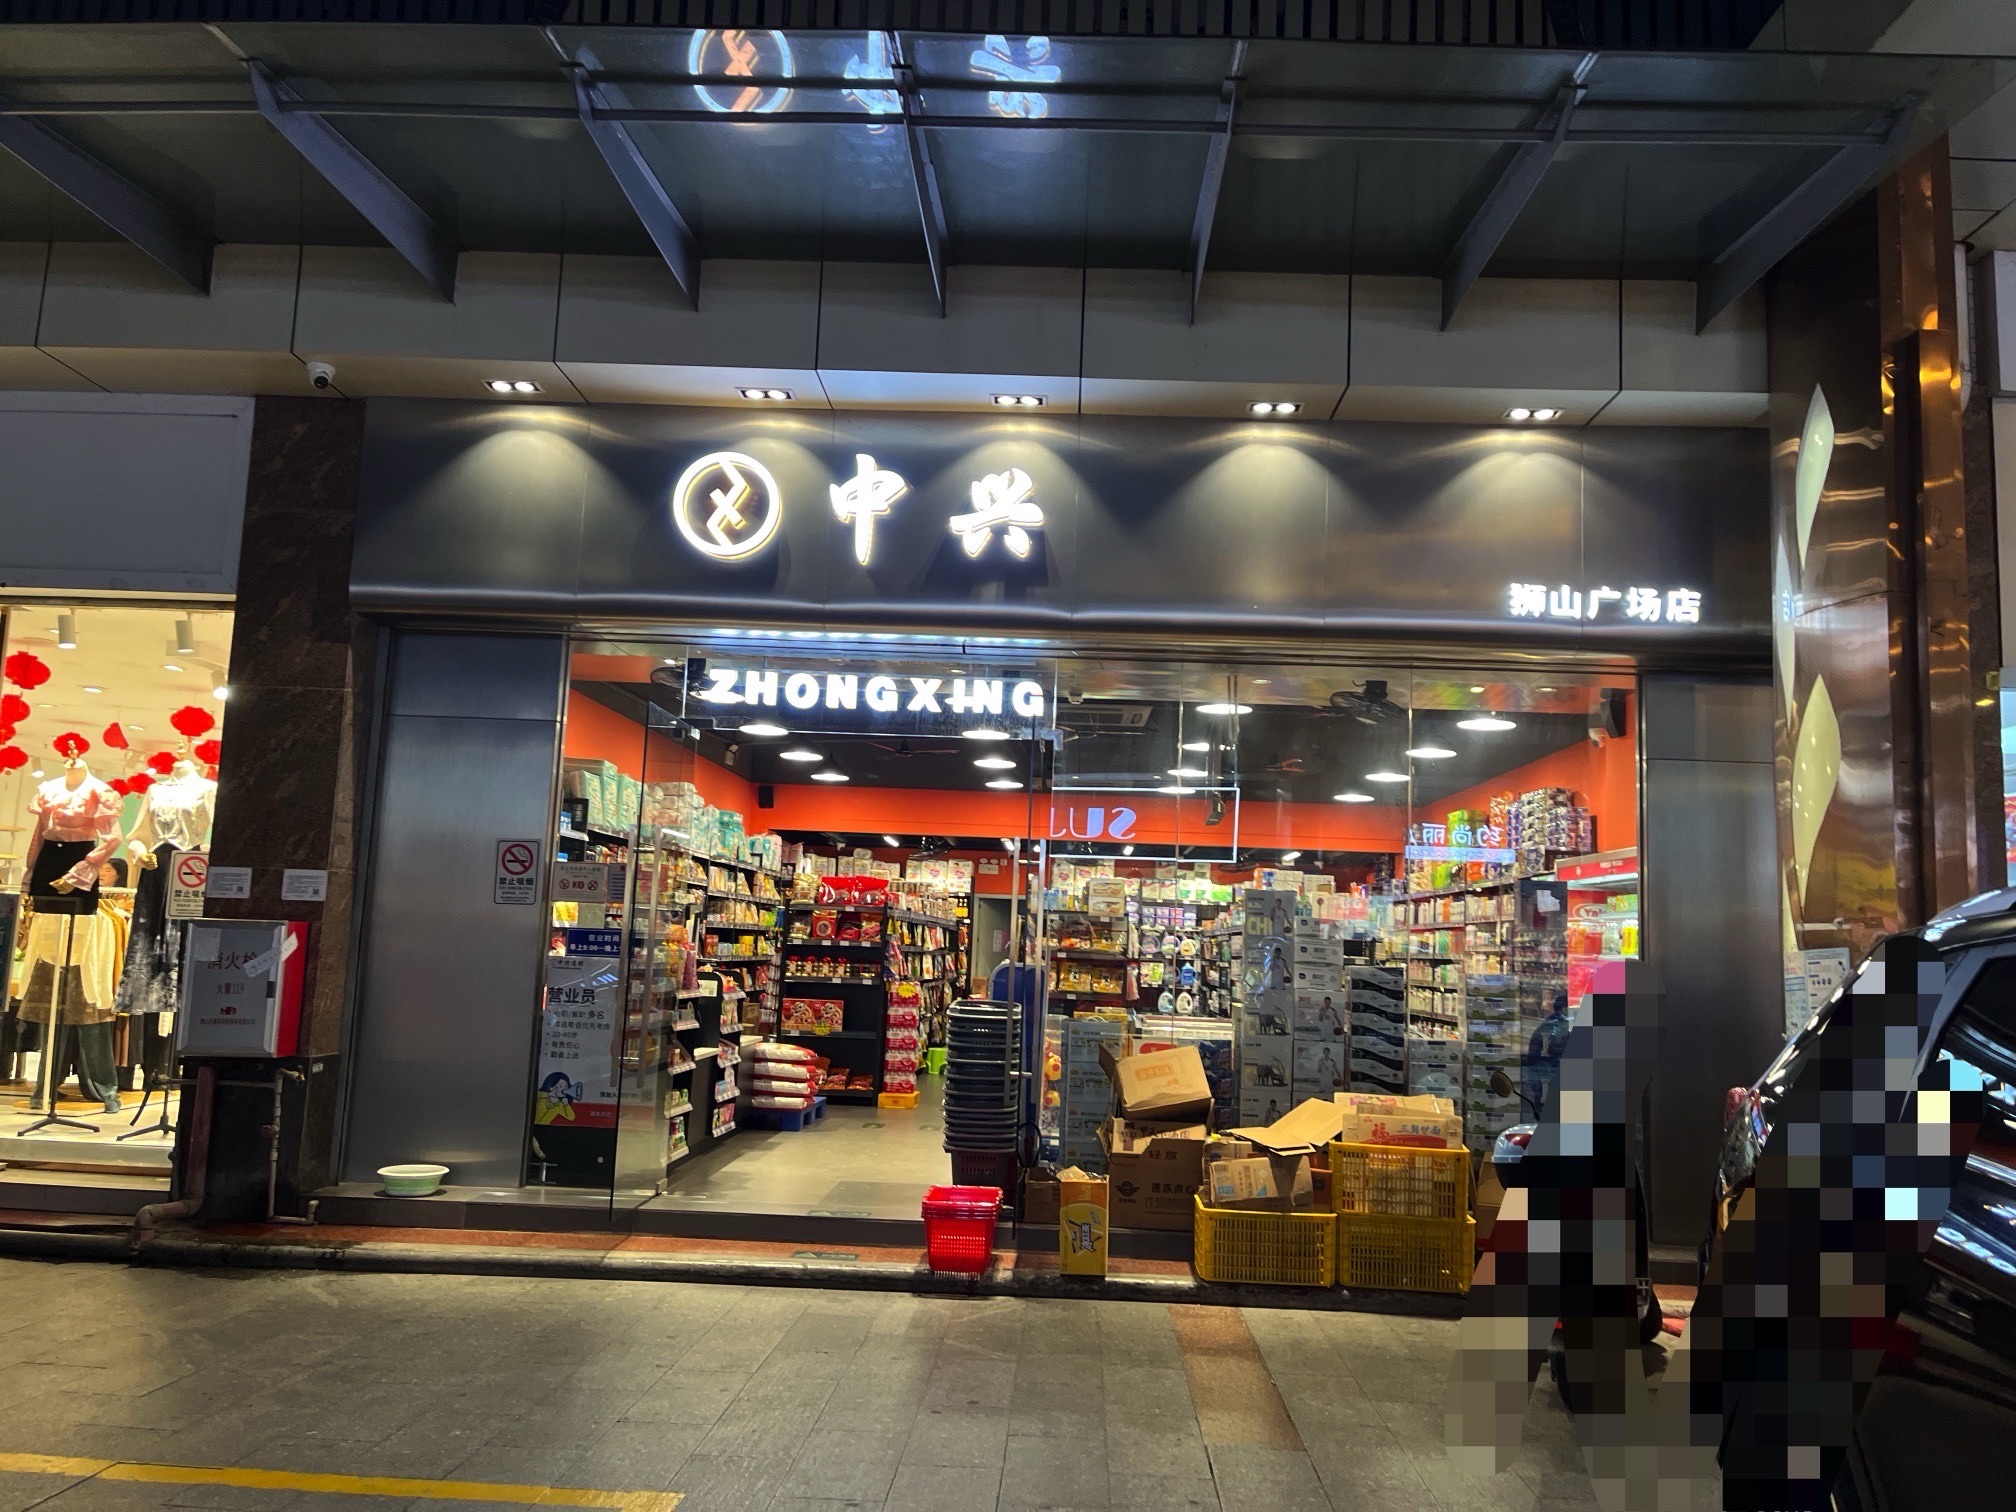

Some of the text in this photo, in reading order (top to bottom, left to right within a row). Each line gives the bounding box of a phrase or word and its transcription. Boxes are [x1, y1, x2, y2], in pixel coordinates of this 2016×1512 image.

[830, 453, 1044, 565] 中兴
[1510, 583, 1701, 623] 狮山广场店
[706, 669, 1044, 717] ZHONGXING
[499, 877, 534, 886] 禁止吸烟
[548, 986, 596, 1005] 营业员
